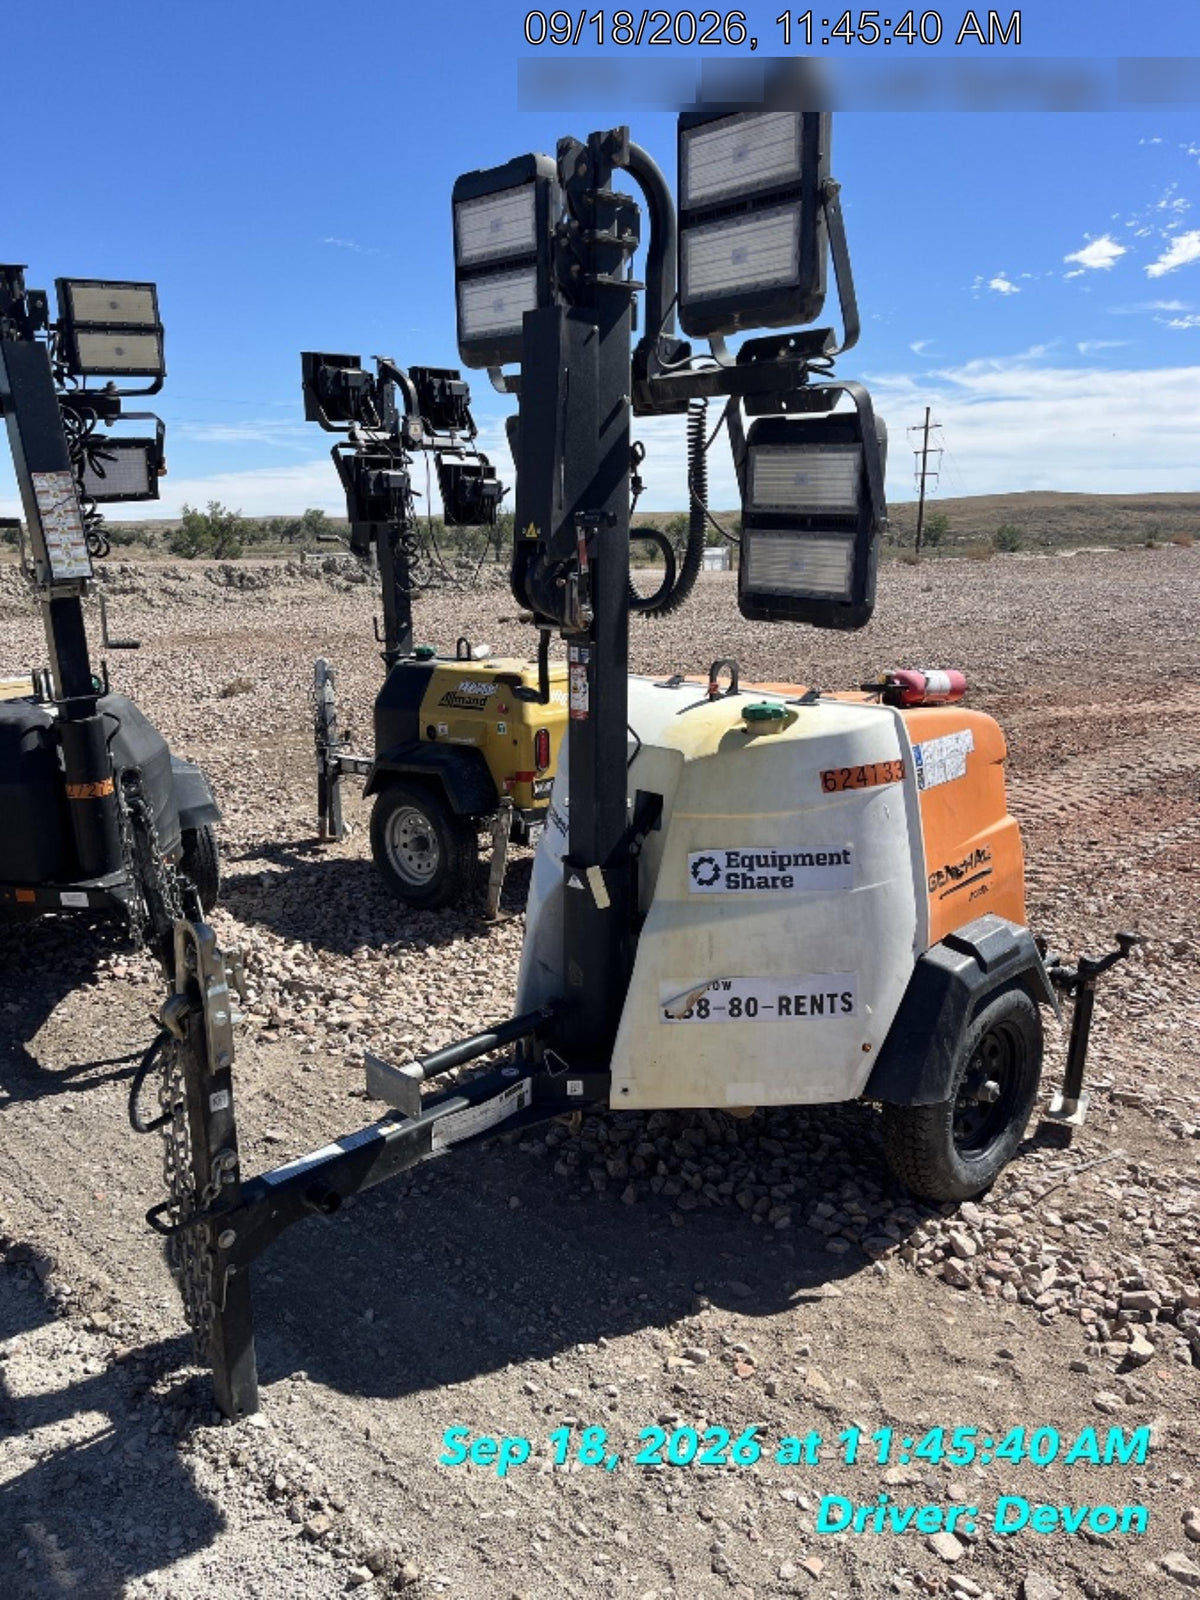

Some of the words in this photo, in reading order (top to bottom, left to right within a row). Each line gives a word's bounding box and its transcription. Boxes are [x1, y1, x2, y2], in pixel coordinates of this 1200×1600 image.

[823, 760, 906, 792] 624133
[725, 849, 851, 872] Equipment
[725, 872, 794, 890] Share
[663, 991, 854, 1019] 8-80-RENTS
